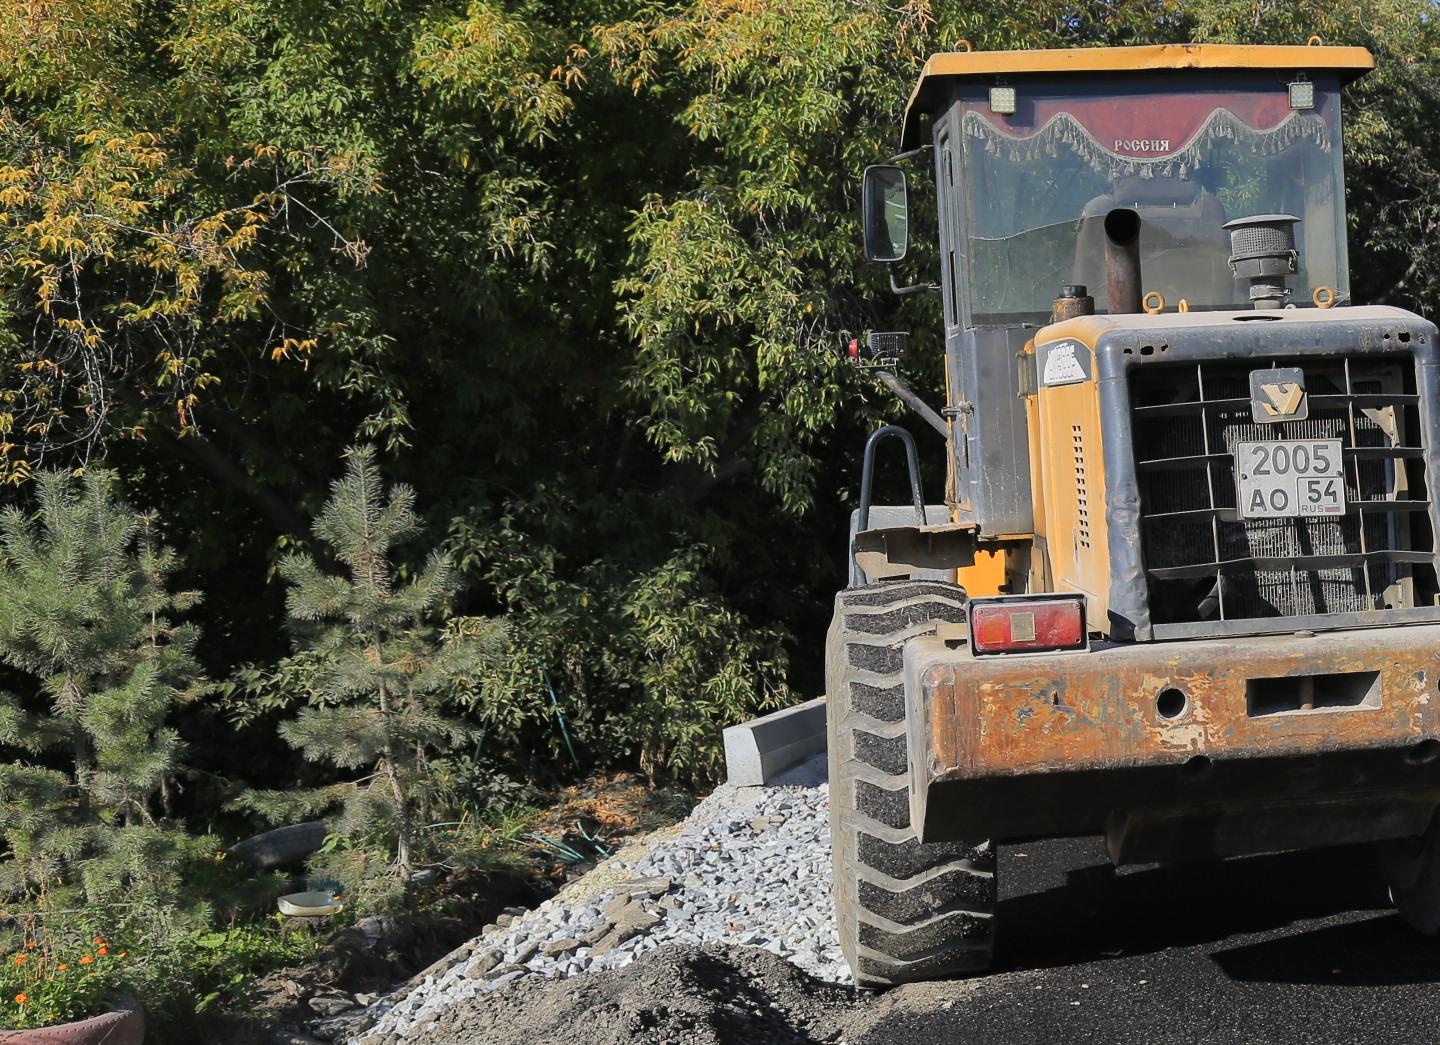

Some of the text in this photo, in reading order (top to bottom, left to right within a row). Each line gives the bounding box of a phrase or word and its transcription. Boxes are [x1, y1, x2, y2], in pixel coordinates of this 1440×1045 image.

[1114, 139, 1169, 151] РОССИЯ
[1252, 445, 1330, 475] 2005
[1308, 480, 1337, 503] 54
[1301, 505, 1324, 513] RUS
